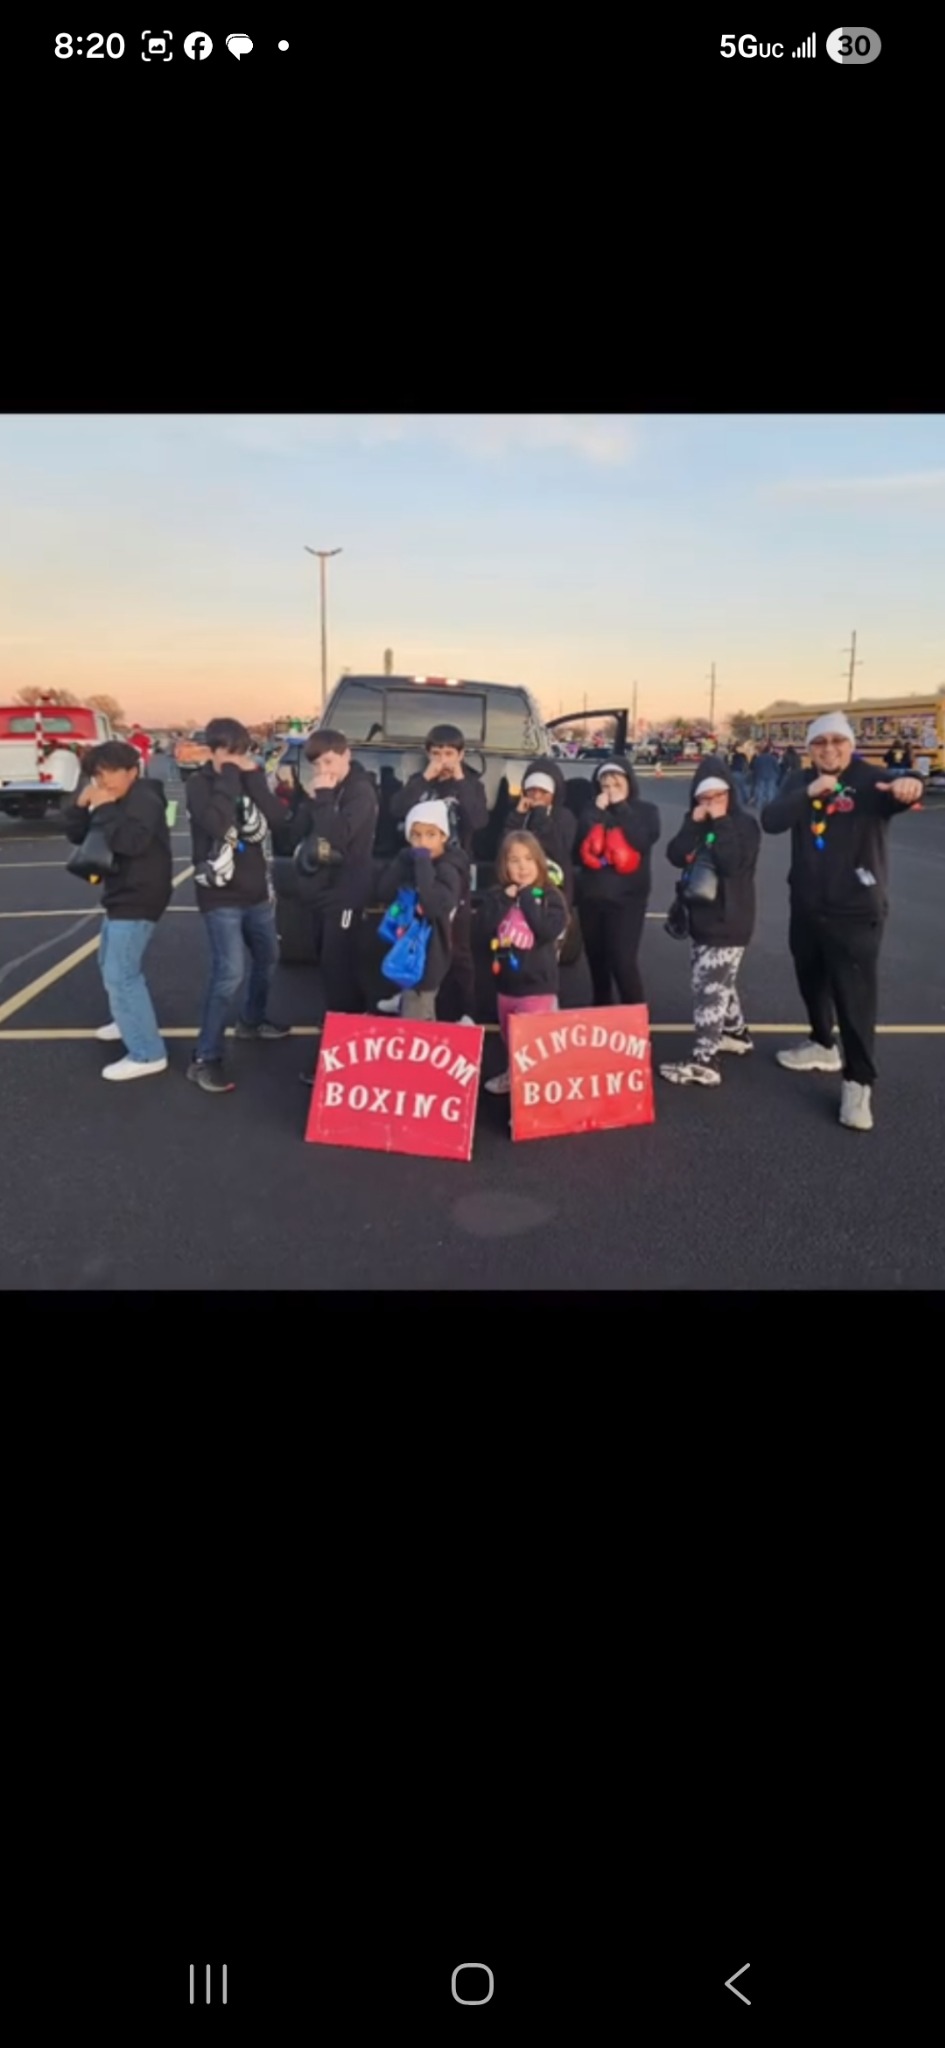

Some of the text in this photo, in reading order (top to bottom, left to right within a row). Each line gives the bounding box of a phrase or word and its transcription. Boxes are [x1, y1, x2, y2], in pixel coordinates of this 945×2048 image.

[320, 1036, 478, 1087] KINGDOM
[514, 1024, 648, 1073] KINGDOM
[324, 1082, 463, 1122] BOXING
[522, 1070, 645, 1106] BOXING
